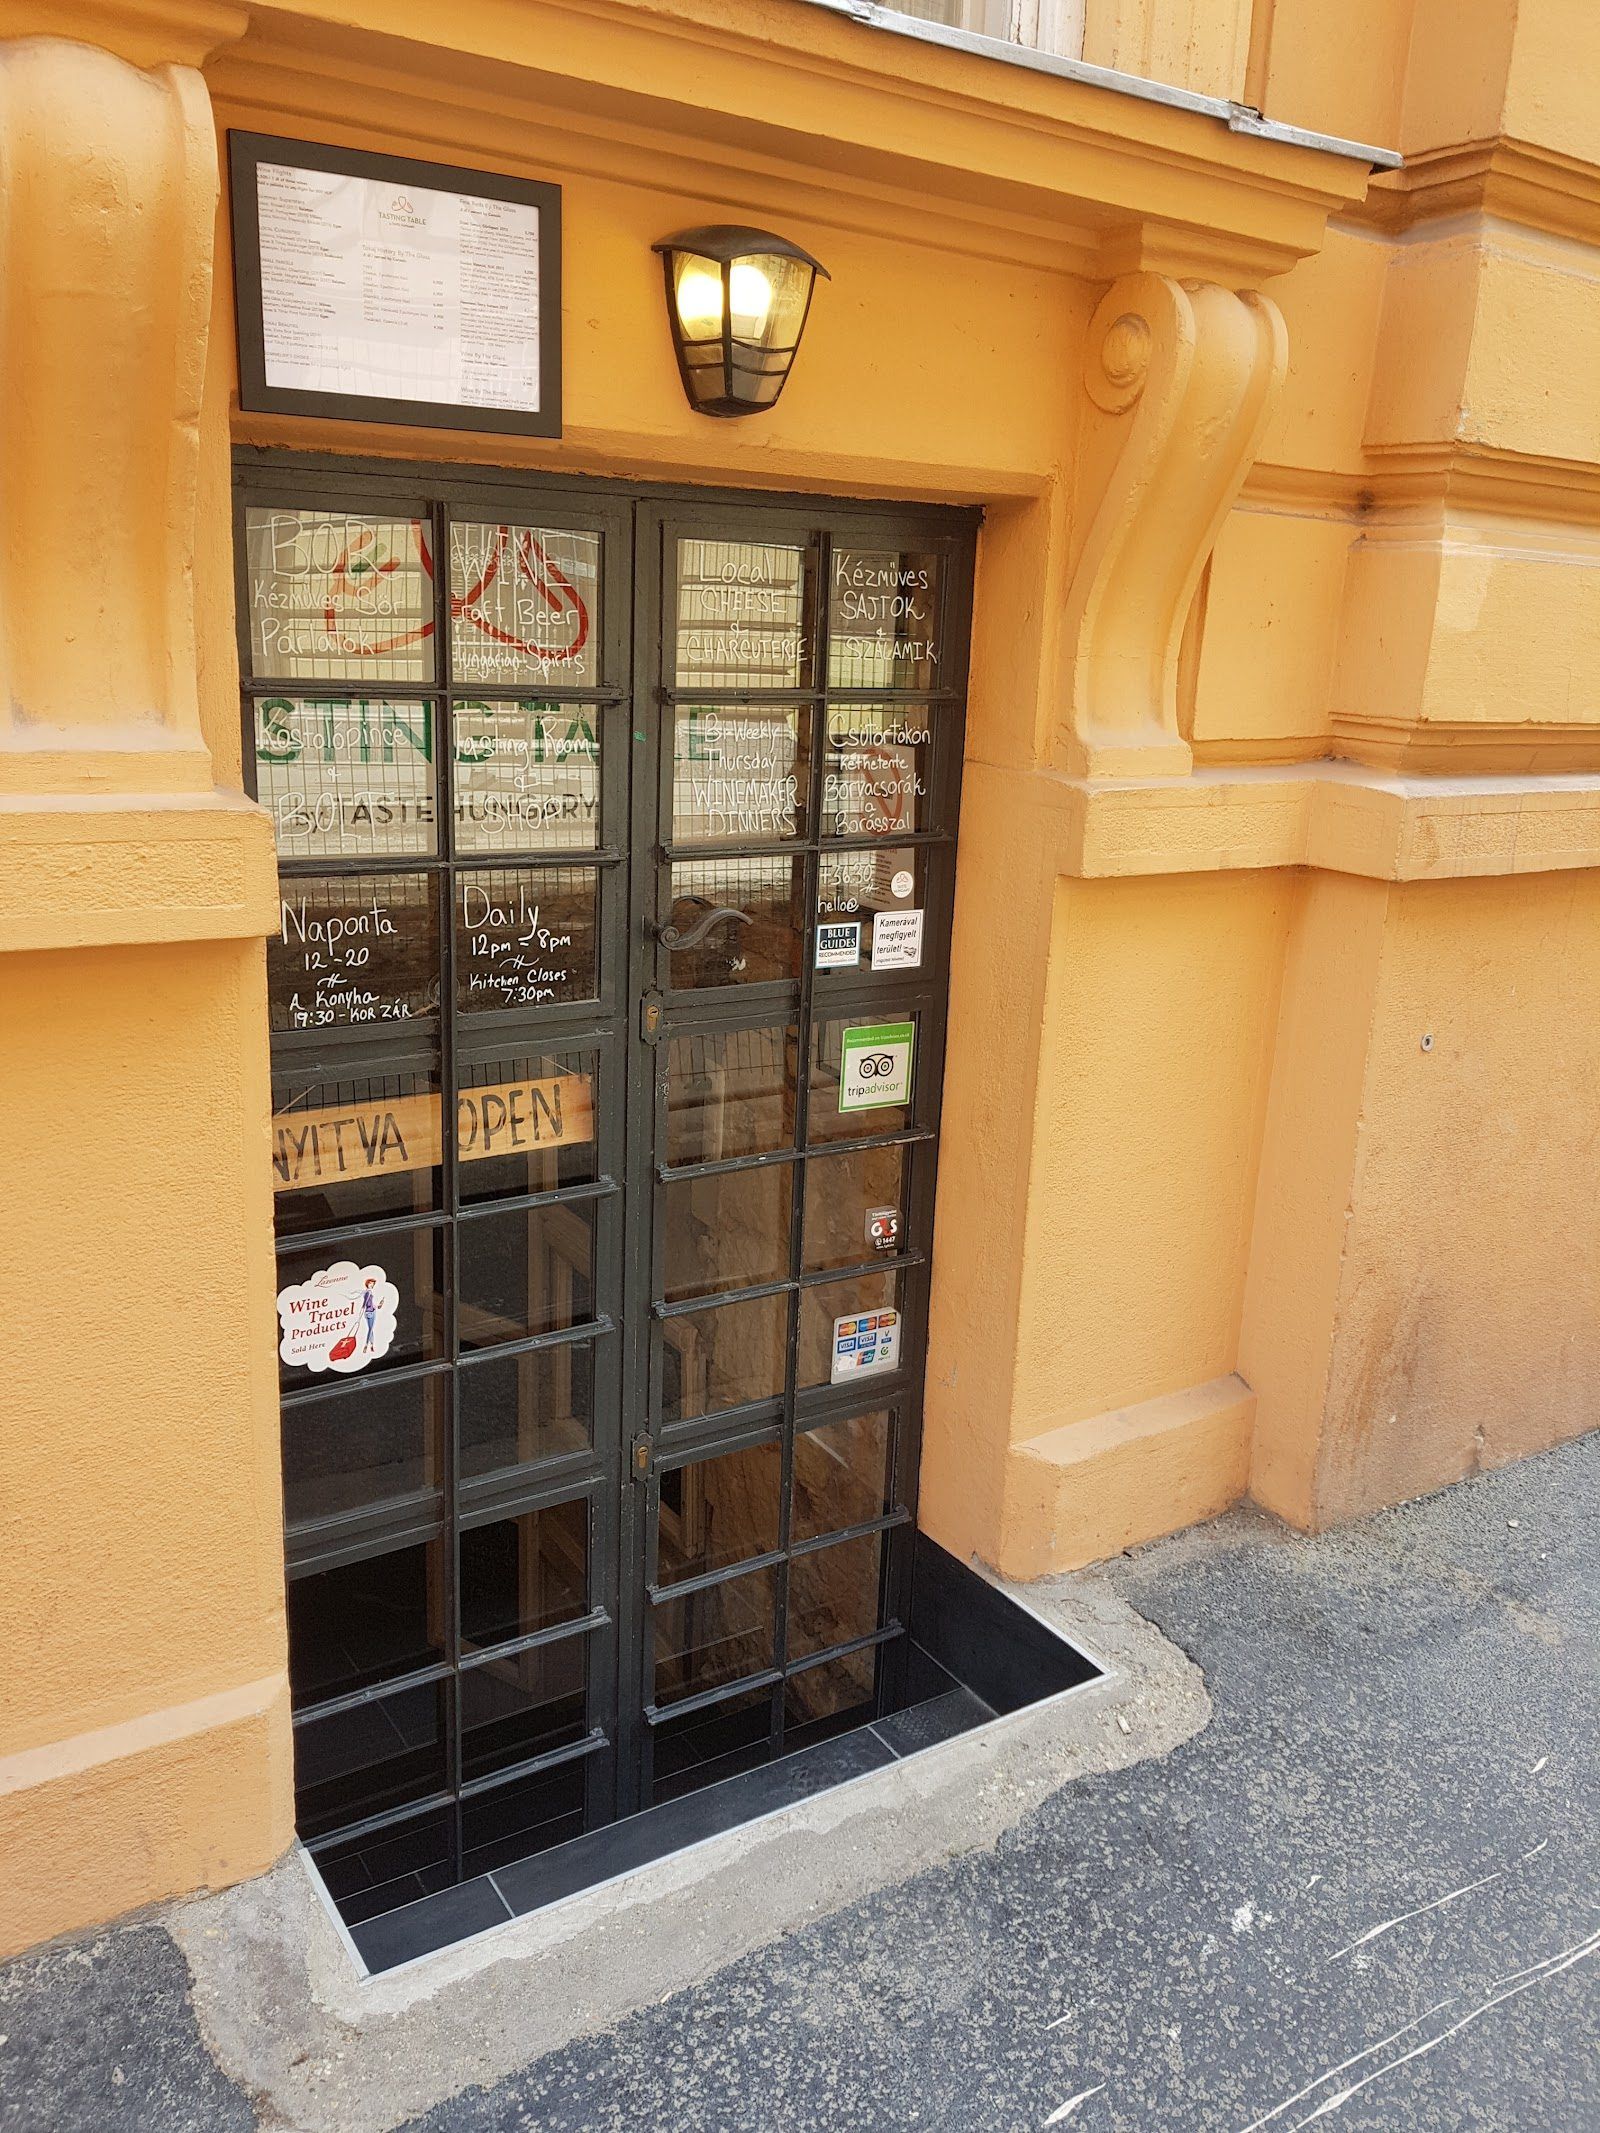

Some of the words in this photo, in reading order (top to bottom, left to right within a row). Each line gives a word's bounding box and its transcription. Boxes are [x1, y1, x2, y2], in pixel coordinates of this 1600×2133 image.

[379, 212, 406, 223] TASTING
[407, 216, 427, 226] TABLE
[271, 515, 400, 581] BOR
[453, 528, 572, 587] WINE
[699, 544, 772, 585] Local
[355, 586, 404, 616] Sör
[451, 595, 506, 623] Craft
[517, 599, 579, 625] Beer
[700, 586, 788, 614] CHEESE
[840, 591, 925, 620] SAJTOK
[526, 638, 585, 678] Spirits
[686, 636, 808, 662] CHARCUTERIE
[453, 709, 531, 771] Tasting
[541, 716, 593, 761] Room
[704, 748, 777, 780] Thursday
[691, 775, 802, 807] WINEMAKER
[279, 791, 394, 839] BOLT
[333, 796, 434, 825] TASTE
[453, 794, 596, 822] HUNGARY
[481, 795, 562, 834] SHOP
[708, 807, 797, 837] DINNERS
[464, 885, 539, 940] Daily
[817, 896, 859, 913] hello@
[282, 897, 398, 956] Naponta
[827, 927, 851, 939] BLUE
[820, 938, 856, 949] GUIDES
[470, 973, 519, 991] Kitchen
[527, 969, 567, 983] Closes
[502, 986, 554, 1003] 7:30pm
[316, 987, 380, 1012] Konyha
[848, 1082, 900, 1098] tripadvisor
[458, 1083, 564, 1152] OPEN
[273, 1112, 408, 1182] NYITVA
[289, 1298, 328, 1314] Wine
[309, 1302, 355, 1323] Travel
[291, 1320, 347, 1340] Products
[291, 1346, 307, 1355] Sold
[308, 1342, 326, 1351] Here
